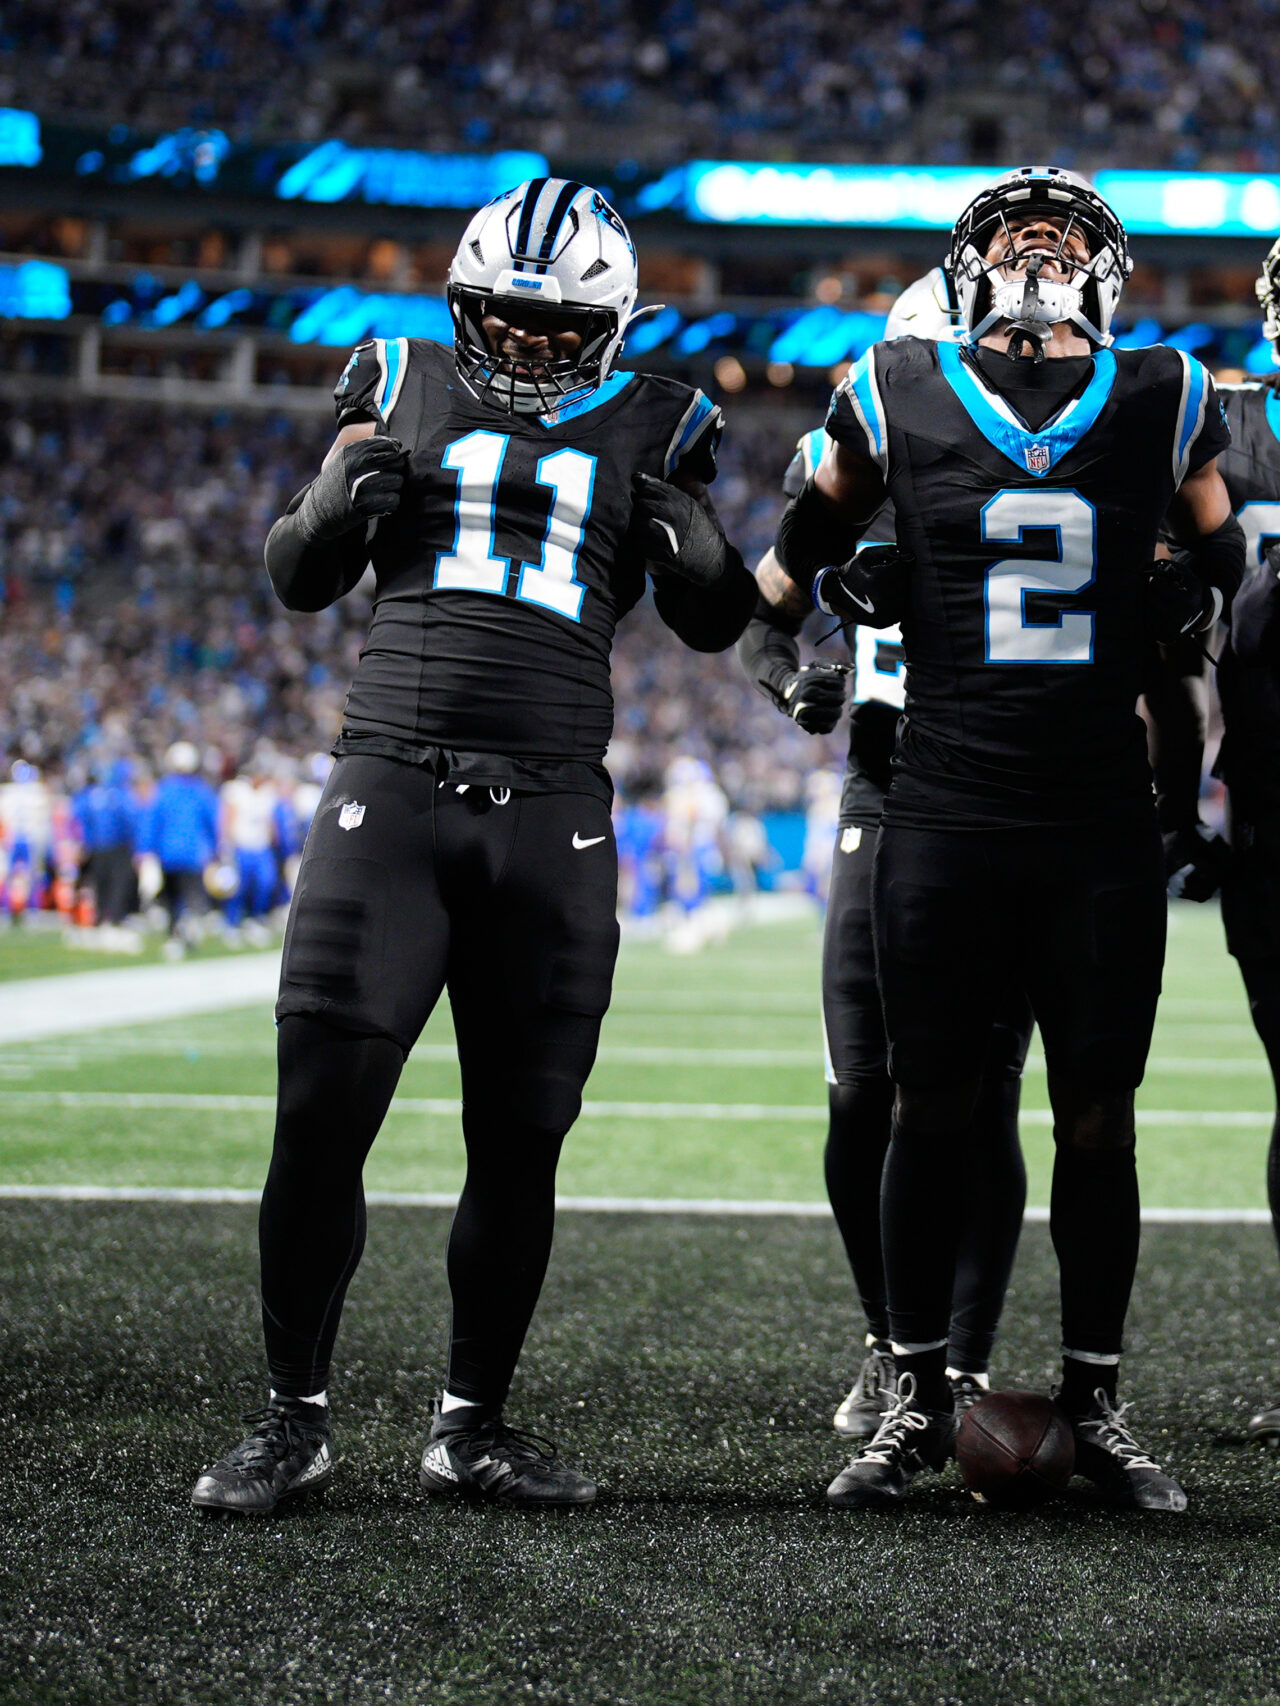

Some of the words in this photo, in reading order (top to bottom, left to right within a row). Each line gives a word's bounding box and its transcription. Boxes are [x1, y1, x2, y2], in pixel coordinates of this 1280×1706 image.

[1029, 456, 1047, 469] NFL
[433, 430, 598, 622] 11
[980, 488, 1098, 664] 2
[424, 1456, 459, 1483] adidas
